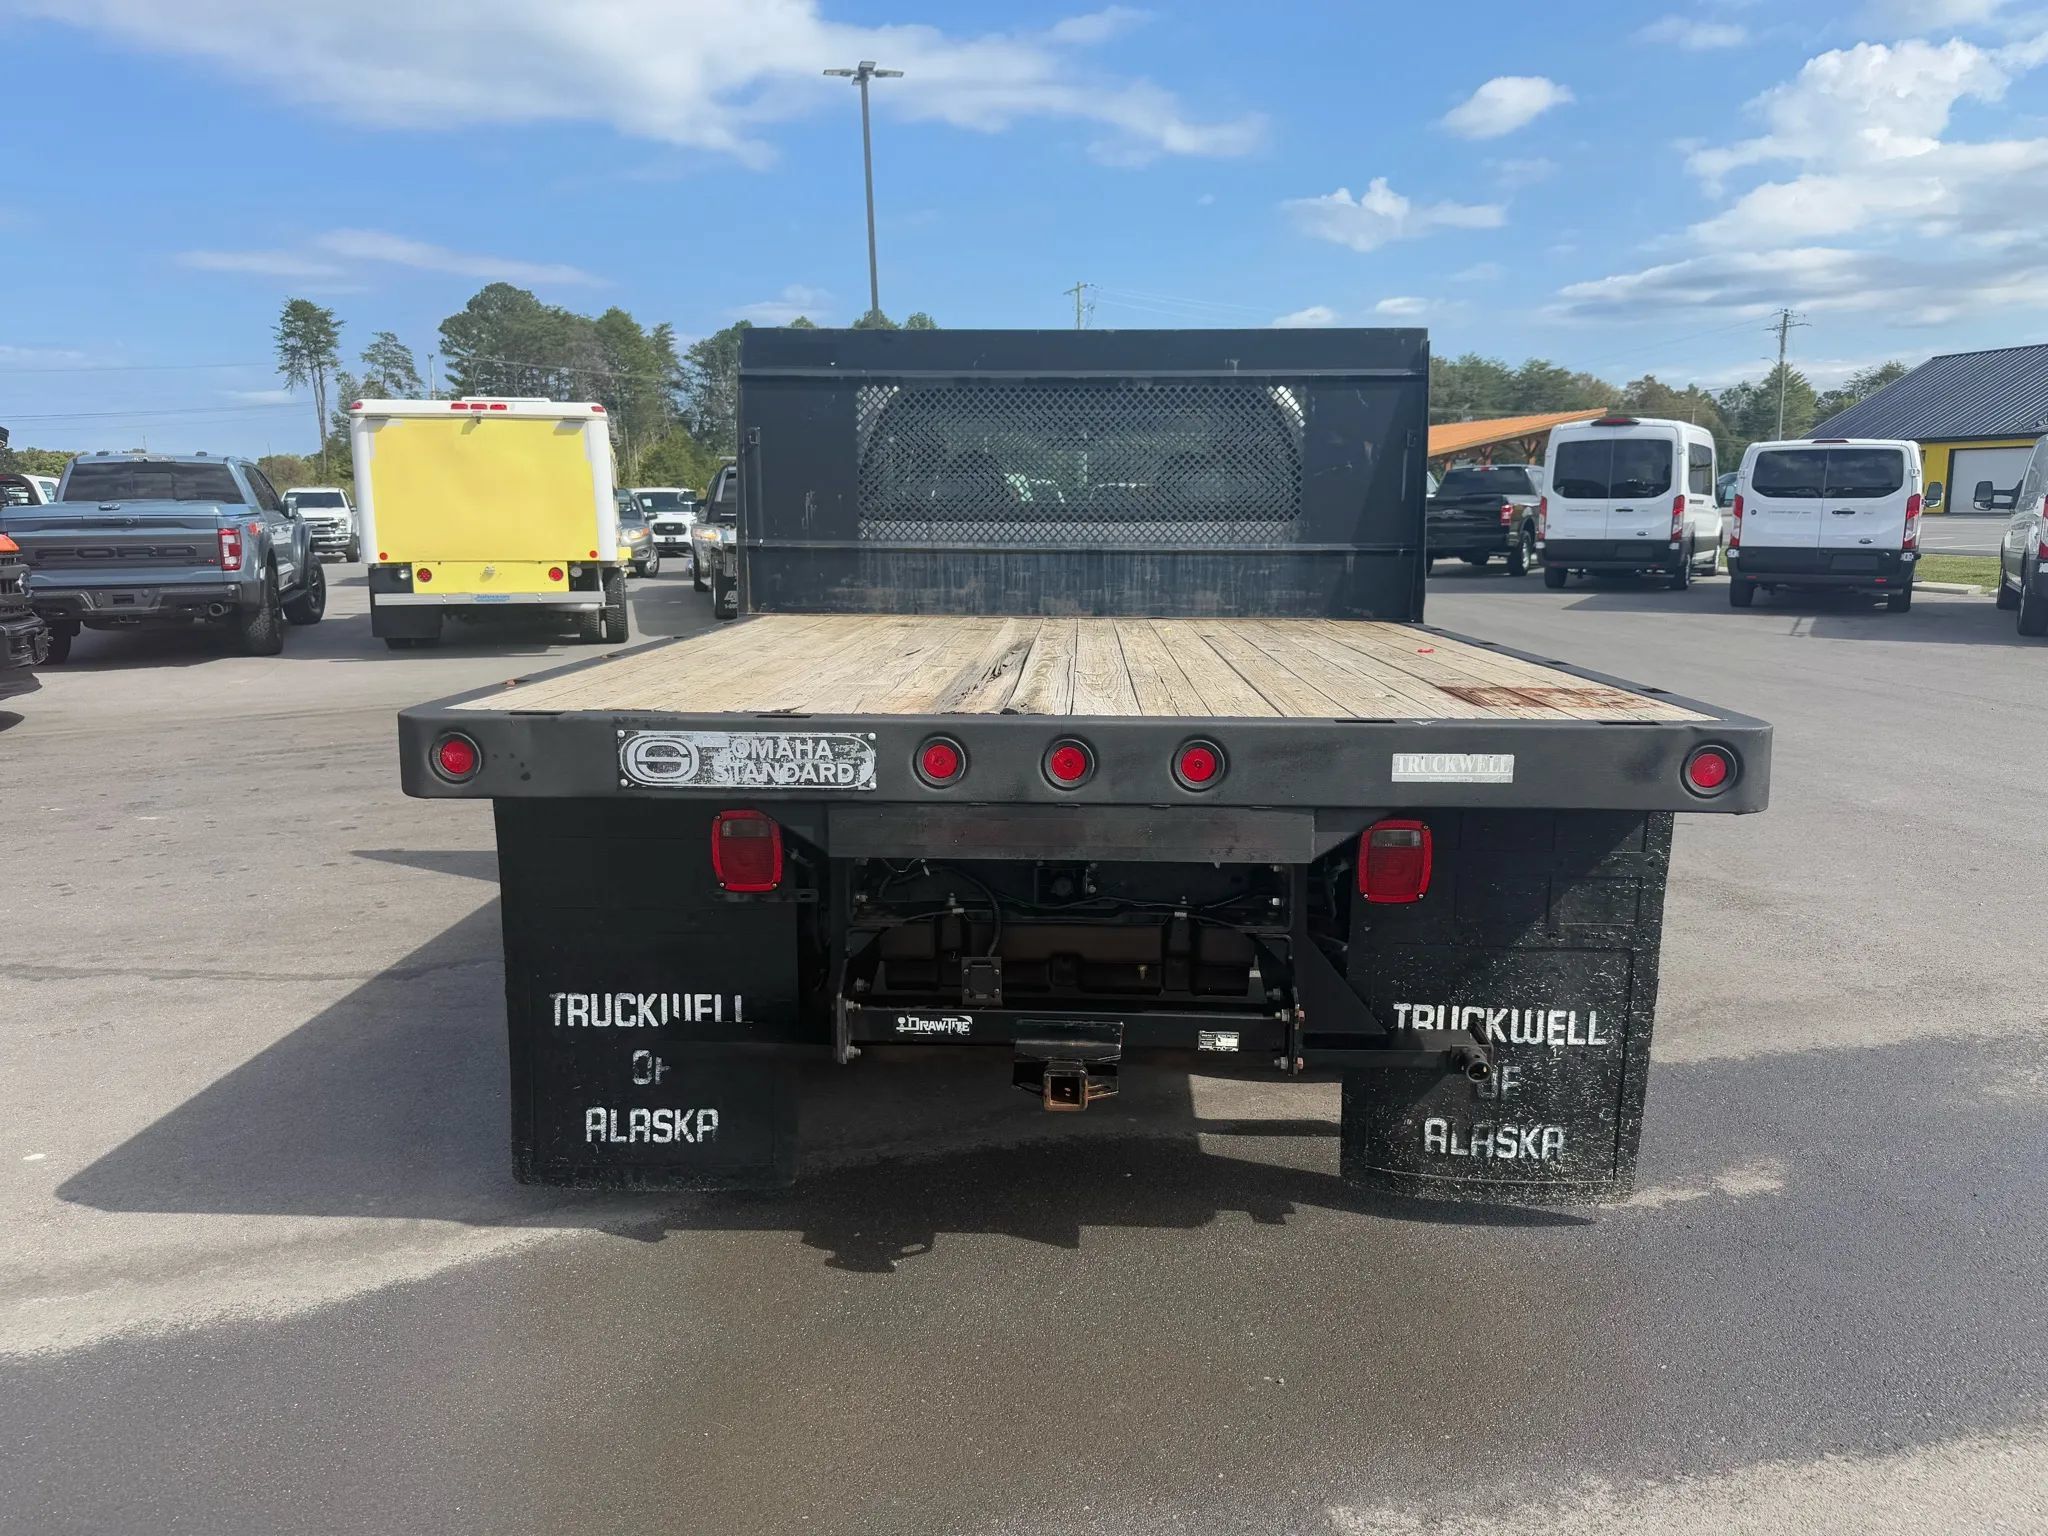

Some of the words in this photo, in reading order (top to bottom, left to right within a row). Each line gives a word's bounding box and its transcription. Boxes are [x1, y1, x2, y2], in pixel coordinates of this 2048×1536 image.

[34, 545, 197, 560] FORD
[731, 738, 834, 760] OMAHA
[713, 762, 856, 784] STANDARD
[1394, 754, 1511, 773] TRUCKWELL
[1393, 1003, 1607, 1046] TRUCKWELL
[585, 1106, 719, 1143] ALASKA
[1424, 1117, 1565, 1159] ALASKA
